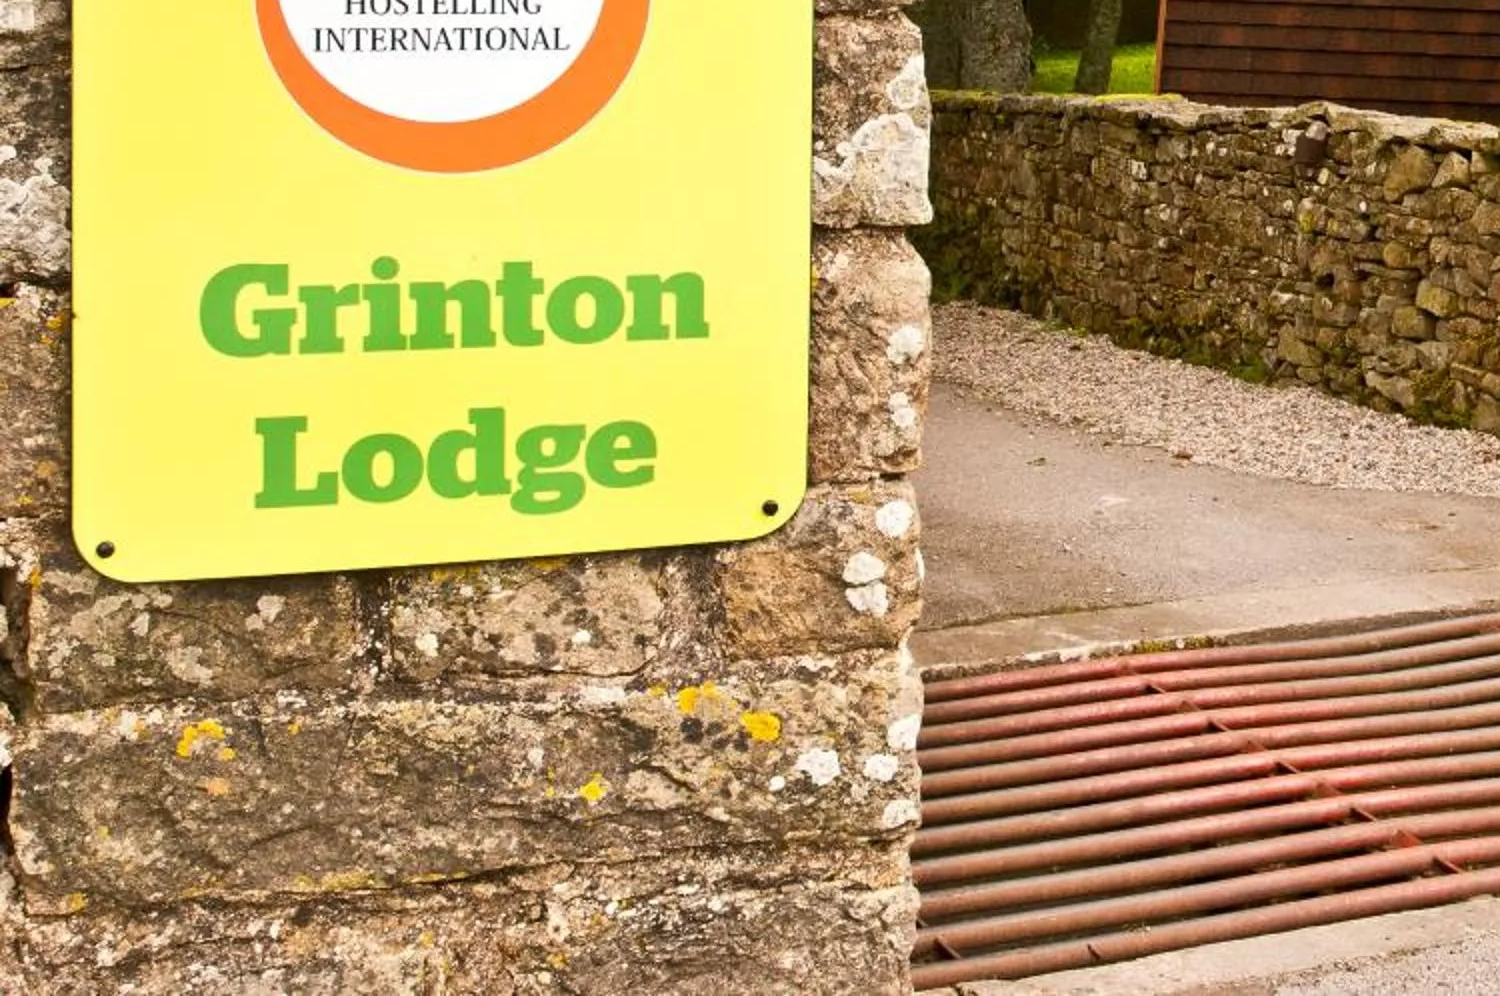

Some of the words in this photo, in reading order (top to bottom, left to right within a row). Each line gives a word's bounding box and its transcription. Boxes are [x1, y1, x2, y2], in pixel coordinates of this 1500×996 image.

[313, 26, 570, 53] INTERNATIONAL
[199, 256, 709, 359] Grinton
[255, 407, 657, 516] Lodge
